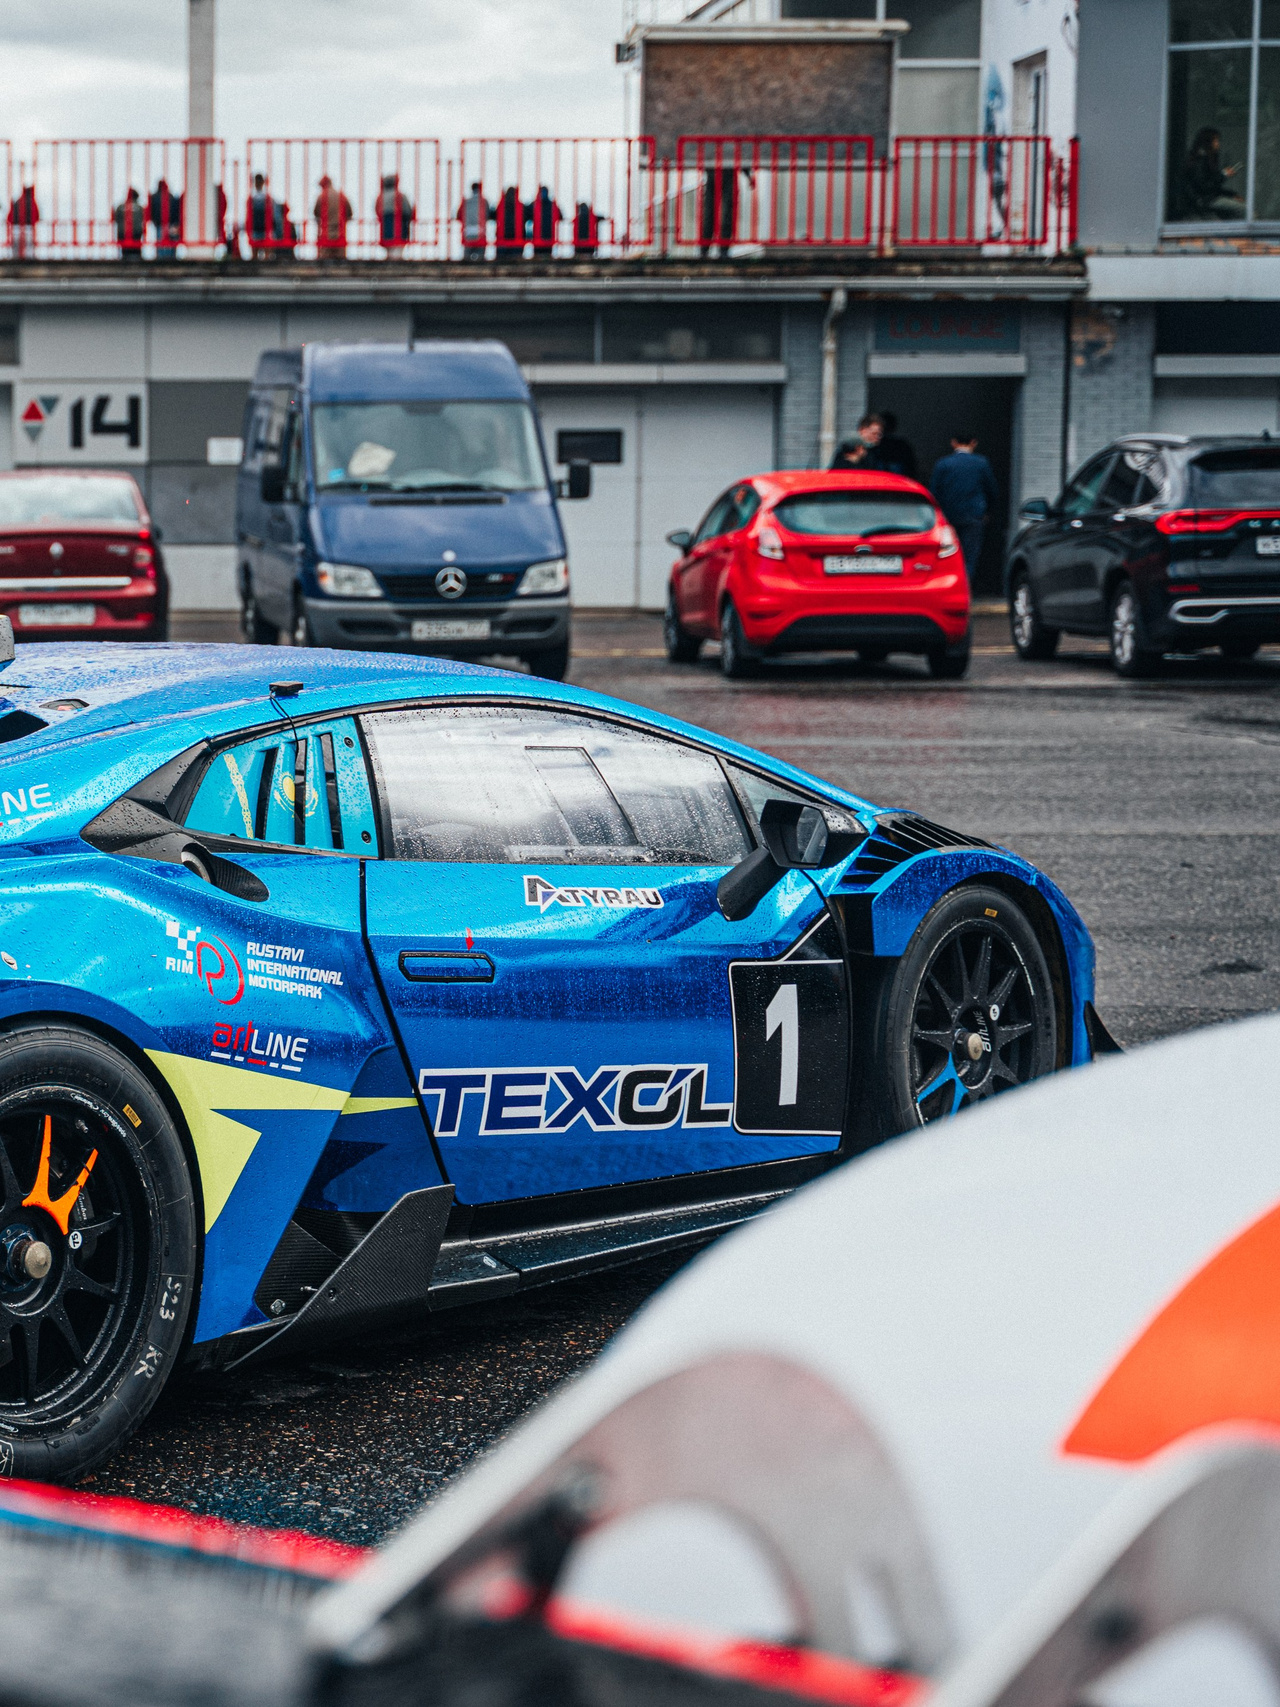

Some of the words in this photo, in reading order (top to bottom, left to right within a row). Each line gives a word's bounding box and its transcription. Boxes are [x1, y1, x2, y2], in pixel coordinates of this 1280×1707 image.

[70, 394, 140, 449] 14
[524, 876, 663, 911] ATYRAU
[166, 957, 194, 975] RIM
[246, 941, 305, 963] RUSTAVI
[247, 958, 344, 986] INTERNATIONAL
[248, 974, 323, 1000] MOTORPARK
[212, 1021, 309, 1062] artLINE
[765, 983, 799, 1106] 1
[416, 1063, 733, 1137] TEXOL
